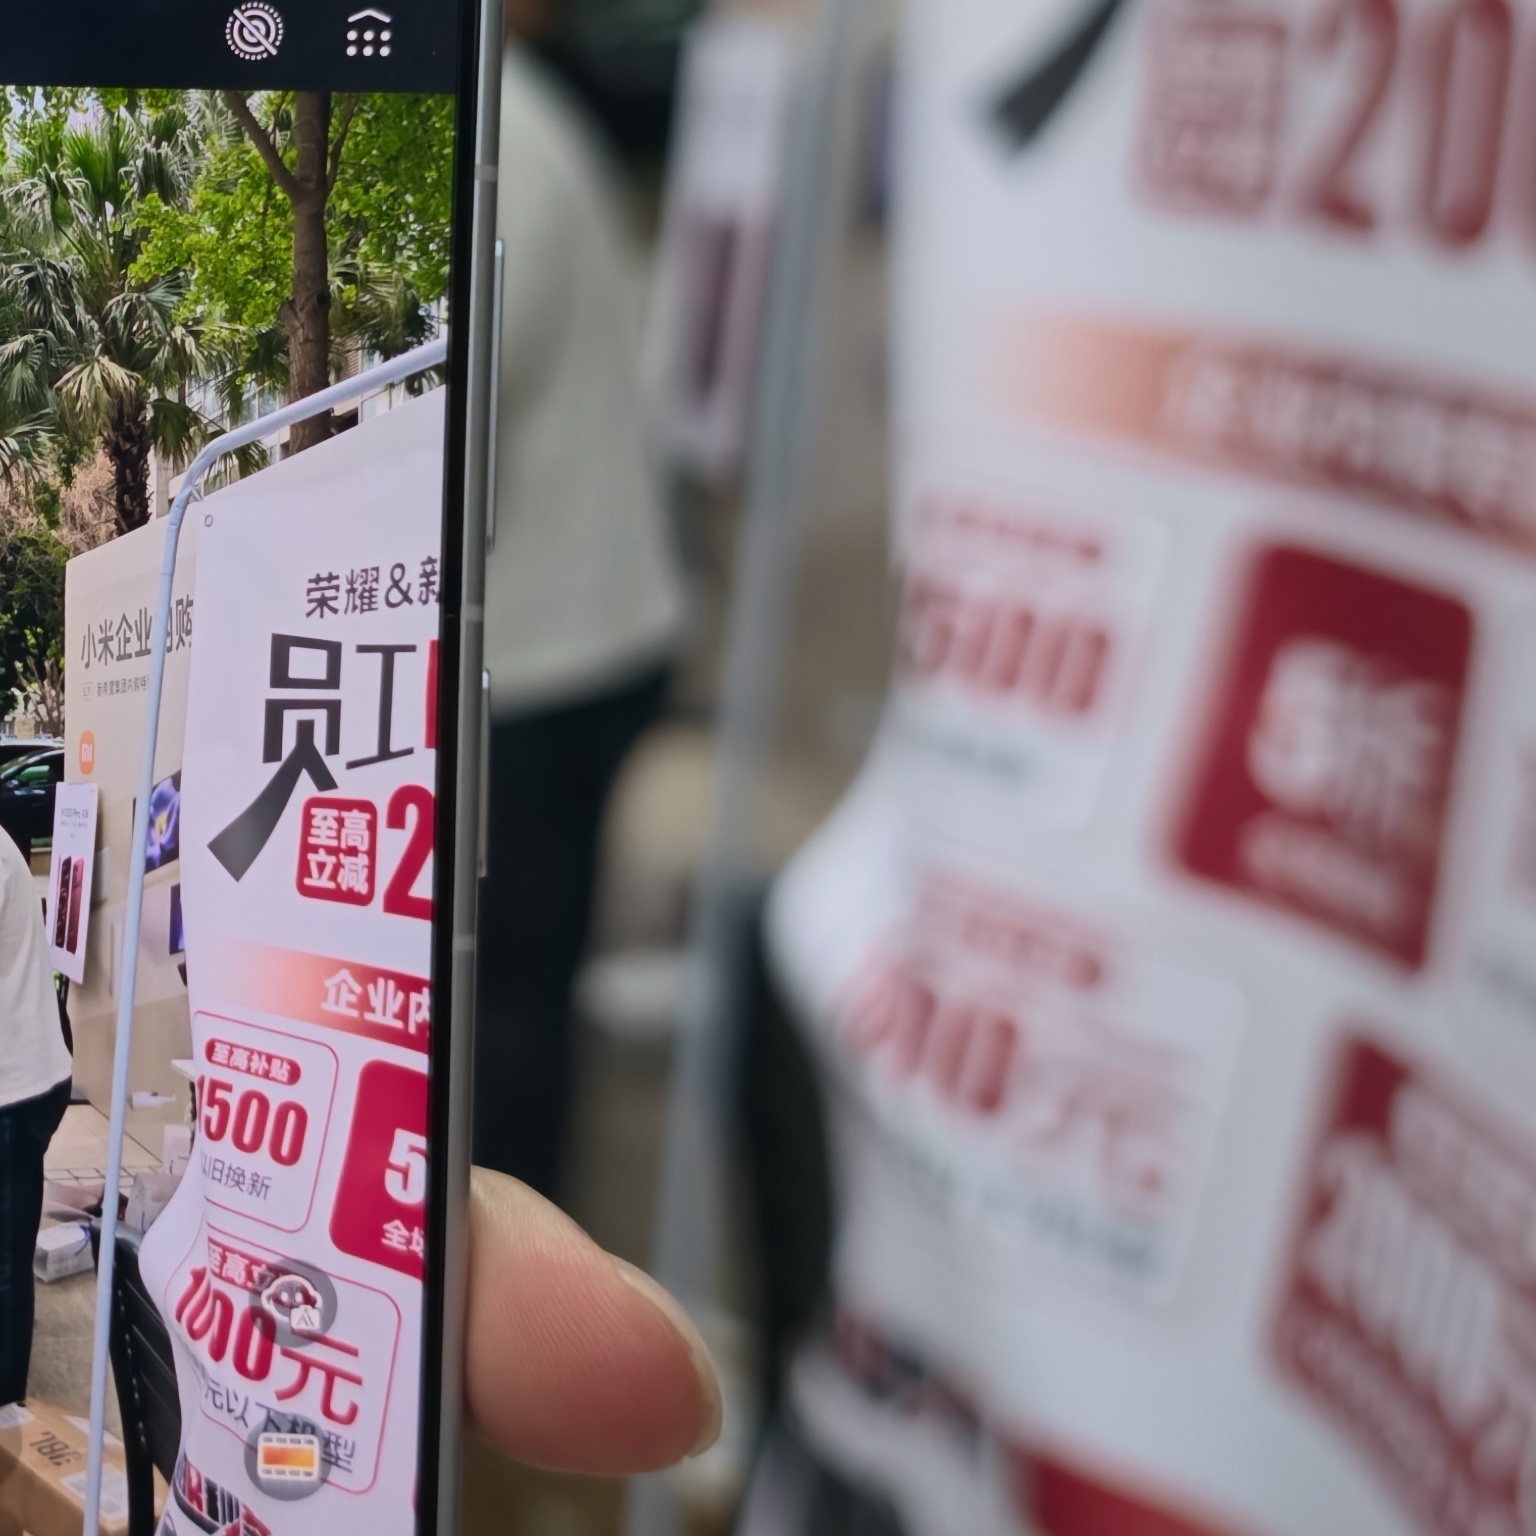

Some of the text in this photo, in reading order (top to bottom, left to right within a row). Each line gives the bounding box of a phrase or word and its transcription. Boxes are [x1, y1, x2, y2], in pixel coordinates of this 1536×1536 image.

[307, 807, 372, 852] 至高
[303, 848, 369, 895] 立减
[383, 784, 435, 922] 2
[211, 1040, 291, 1083] 至高补贴
